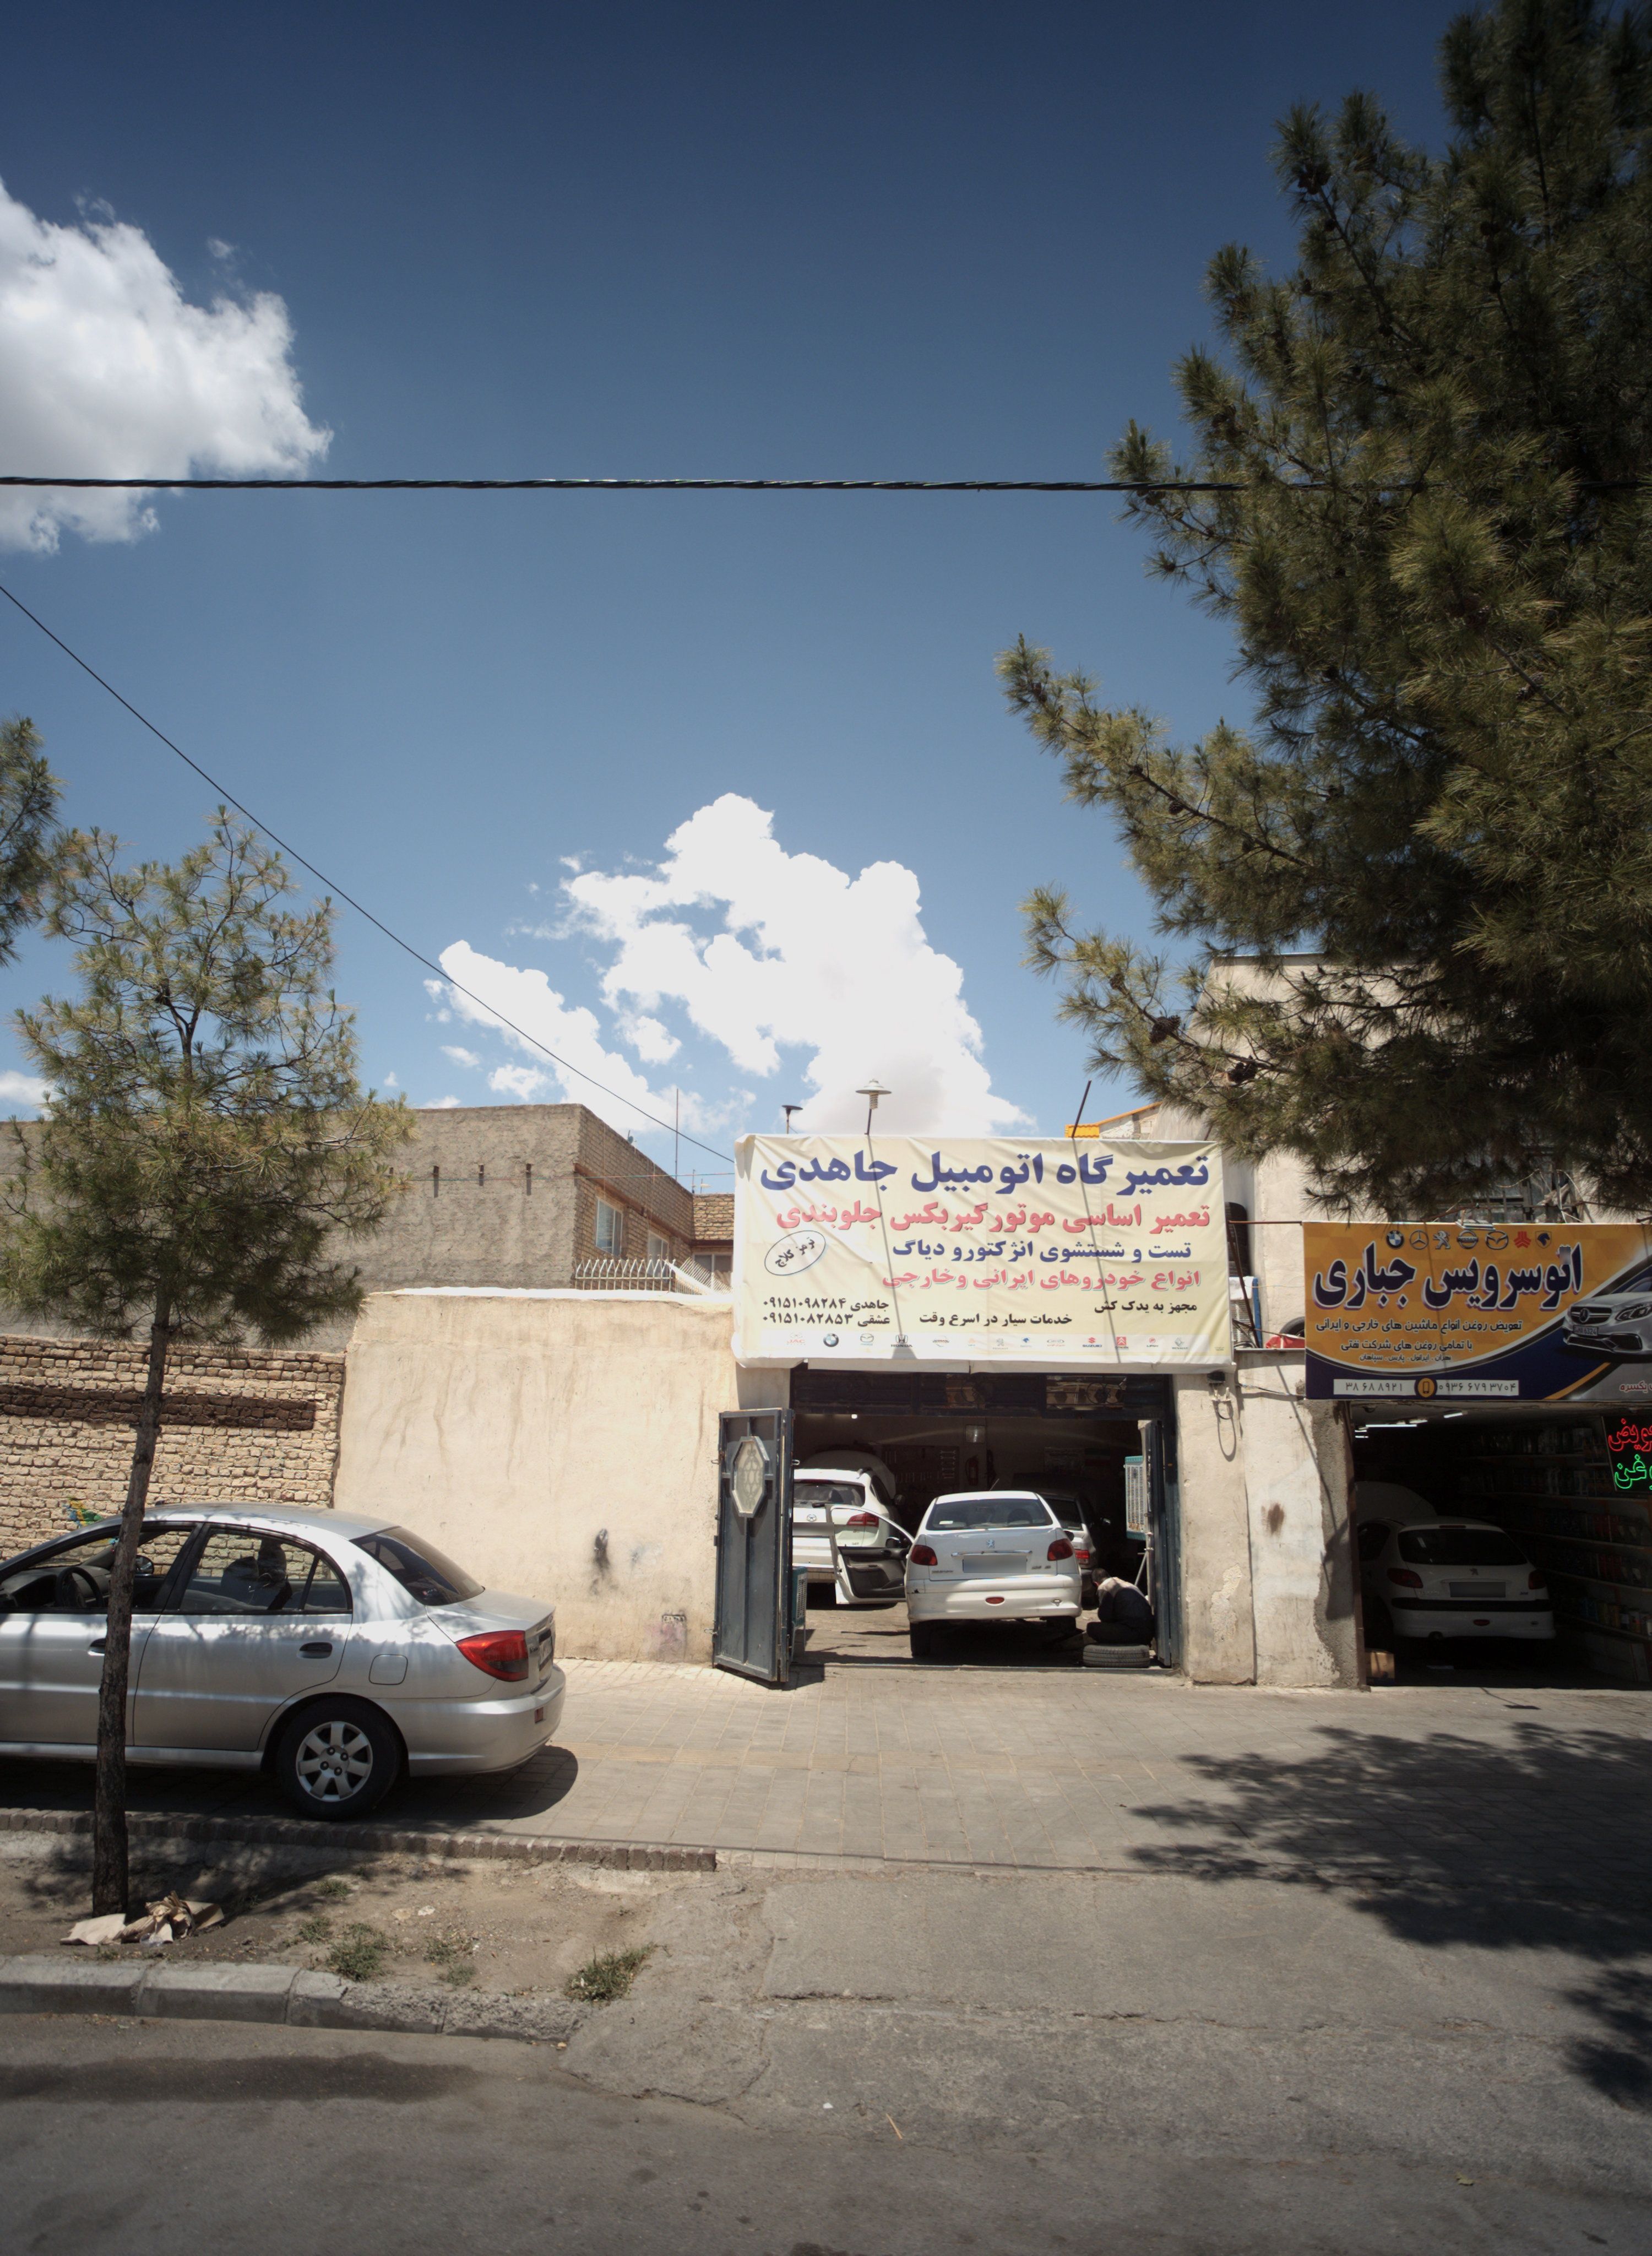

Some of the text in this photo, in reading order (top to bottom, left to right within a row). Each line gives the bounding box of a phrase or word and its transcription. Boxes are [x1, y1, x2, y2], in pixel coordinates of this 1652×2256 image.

[760, 1149, 898, 1191] جاهدی
[911, 1151, 1043, 1195] اتومبیل
[776, 1200, 1210, 1234] تعمیر اساسی موتور گیربکس جلوبندی
[775, 1237, 815, 1267] ترمز کلاچ
[893, 1239, 945, 1260] دیاگ
[1040, 1241, 1125, 1263] شستشوی
[1131, 1249, 1142, 1263] و
[1149, 1242, 1191, 1259] تست
[972, 1268, 1034, 1290] ایرانی
[1040, 1268, 1144, 1291] خودروهای
[1151, 1270, 1200, 1290] انواع
[1312, 1240, 1417, 1309] جباری
[850, 1299, 889, 1311] جاهدی
[1094, 1300, 1198, 1315] مجهز به یدک کش
[857, 1315, 890, 1327] عشقی
[920, 1312, 1072, 1327] خدمات سیار در اسرع وقت
[1316, 1319, 1523, 1334] تعویض روغن انواع ماشین های خارجی و ایرانی
[1340, 1340, 1472, 1352] با تمامی روغن های شرکت نفتی
[1359, 1353, 1383, 1363] سپاهان
[1388, 1354, 1405, 1363] پارس
